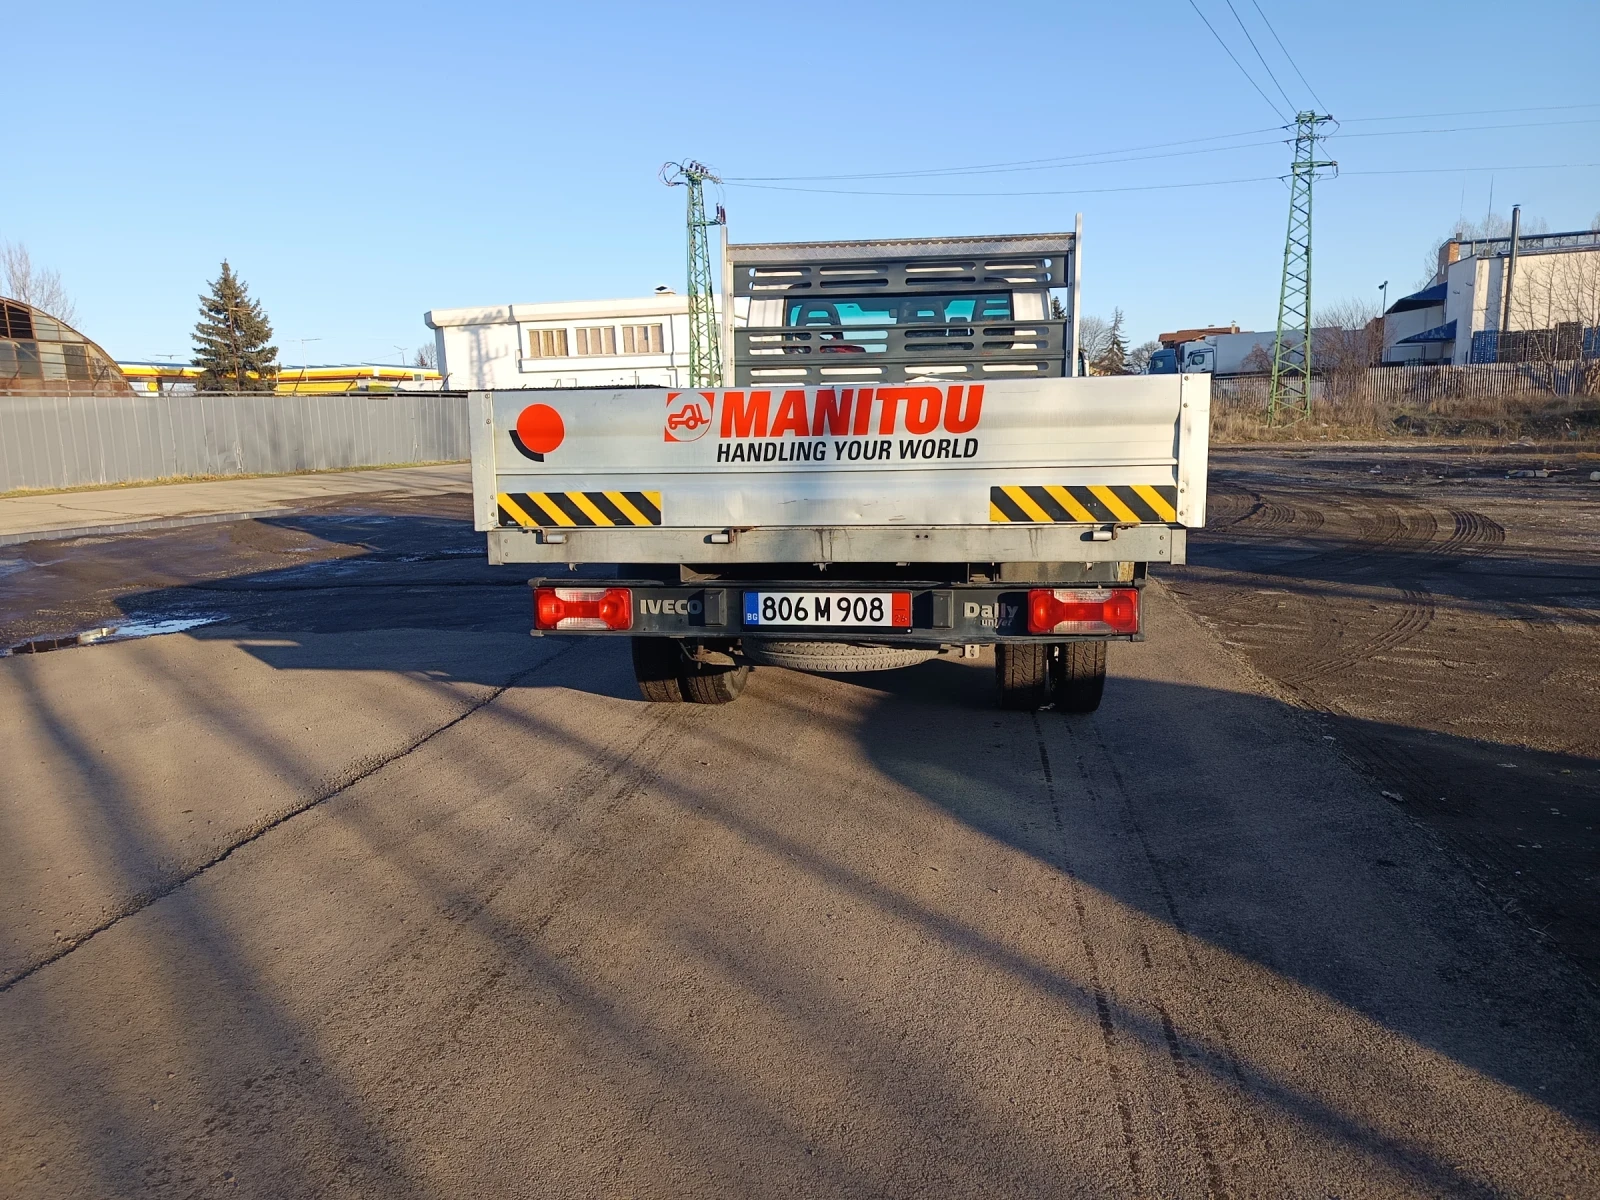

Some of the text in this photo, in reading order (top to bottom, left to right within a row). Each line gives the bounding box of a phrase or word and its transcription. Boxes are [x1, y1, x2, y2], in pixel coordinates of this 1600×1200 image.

[720, 385, 985, 438] MANITOU
[716, 438, 979, 462] HANDLING YOUR WORLD
[640, 599, 703, 615] IVECO
[747, 613, 758, 621] BG
[762, 596, 884, 623] 806 M 908
